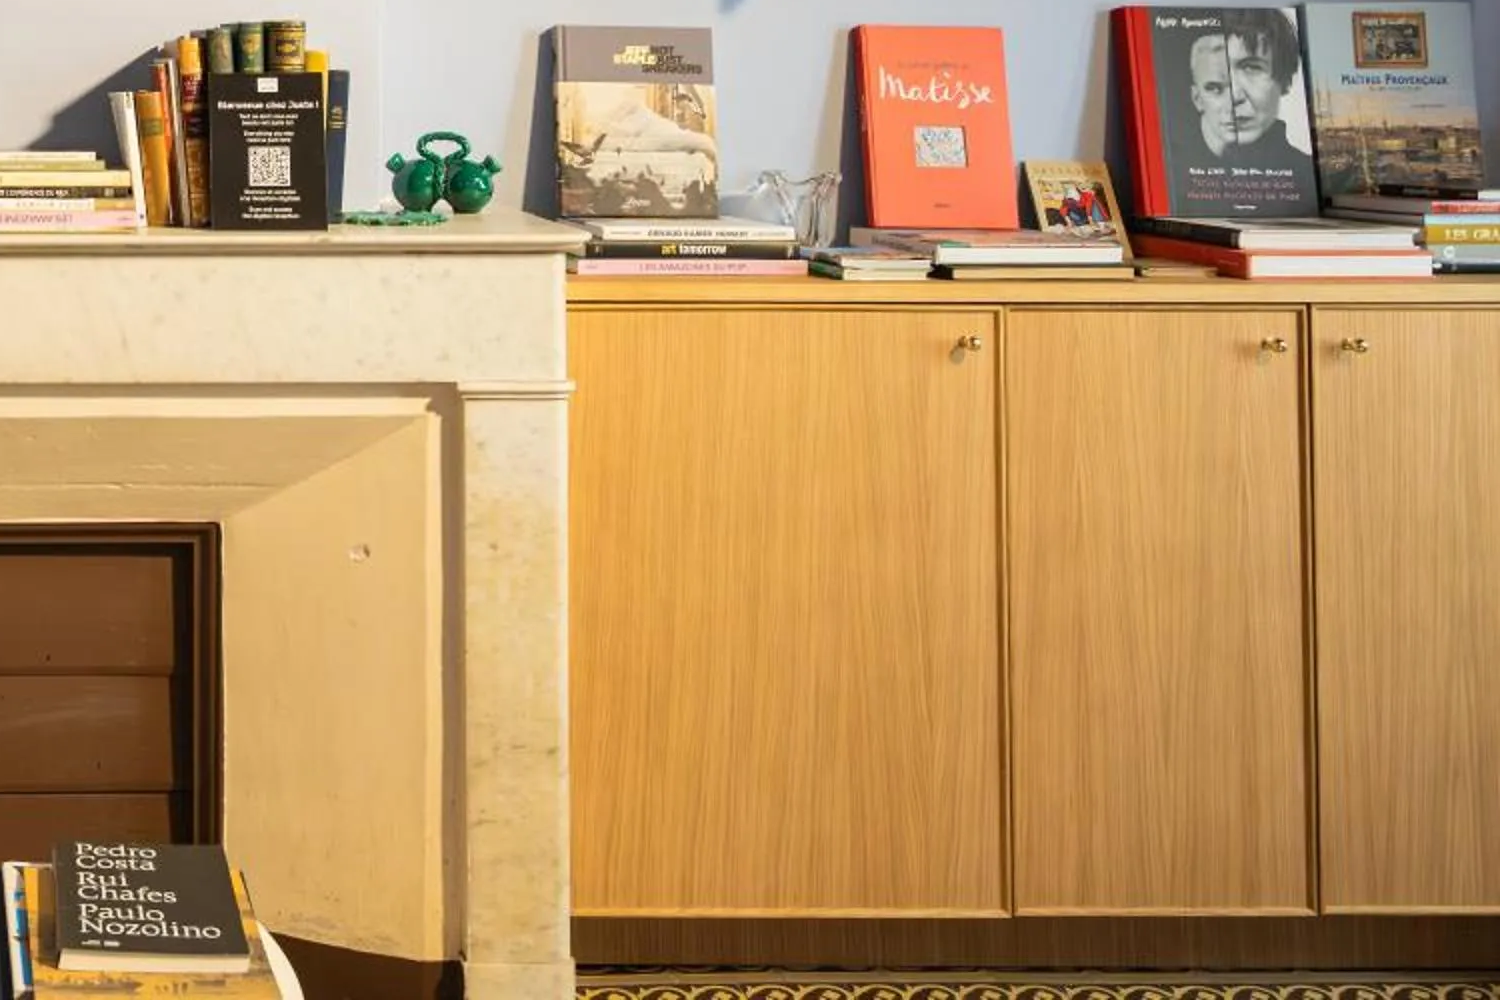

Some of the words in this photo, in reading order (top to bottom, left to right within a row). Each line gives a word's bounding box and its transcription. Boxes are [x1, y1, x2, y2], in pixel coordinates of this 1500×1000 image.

[878, 66, 995, 109] Matisse
[1445, 229, 1467, 240] LES
[75, 842, 157, 859] Pedro
[75, 855, 157, 871] Costa
[76, 871, 129, 887] Rui
[77, 885, 177, 903] Chafes
[78, 904, 165, 921] Paulo
[79, 919, 221, 939] Nozolino
